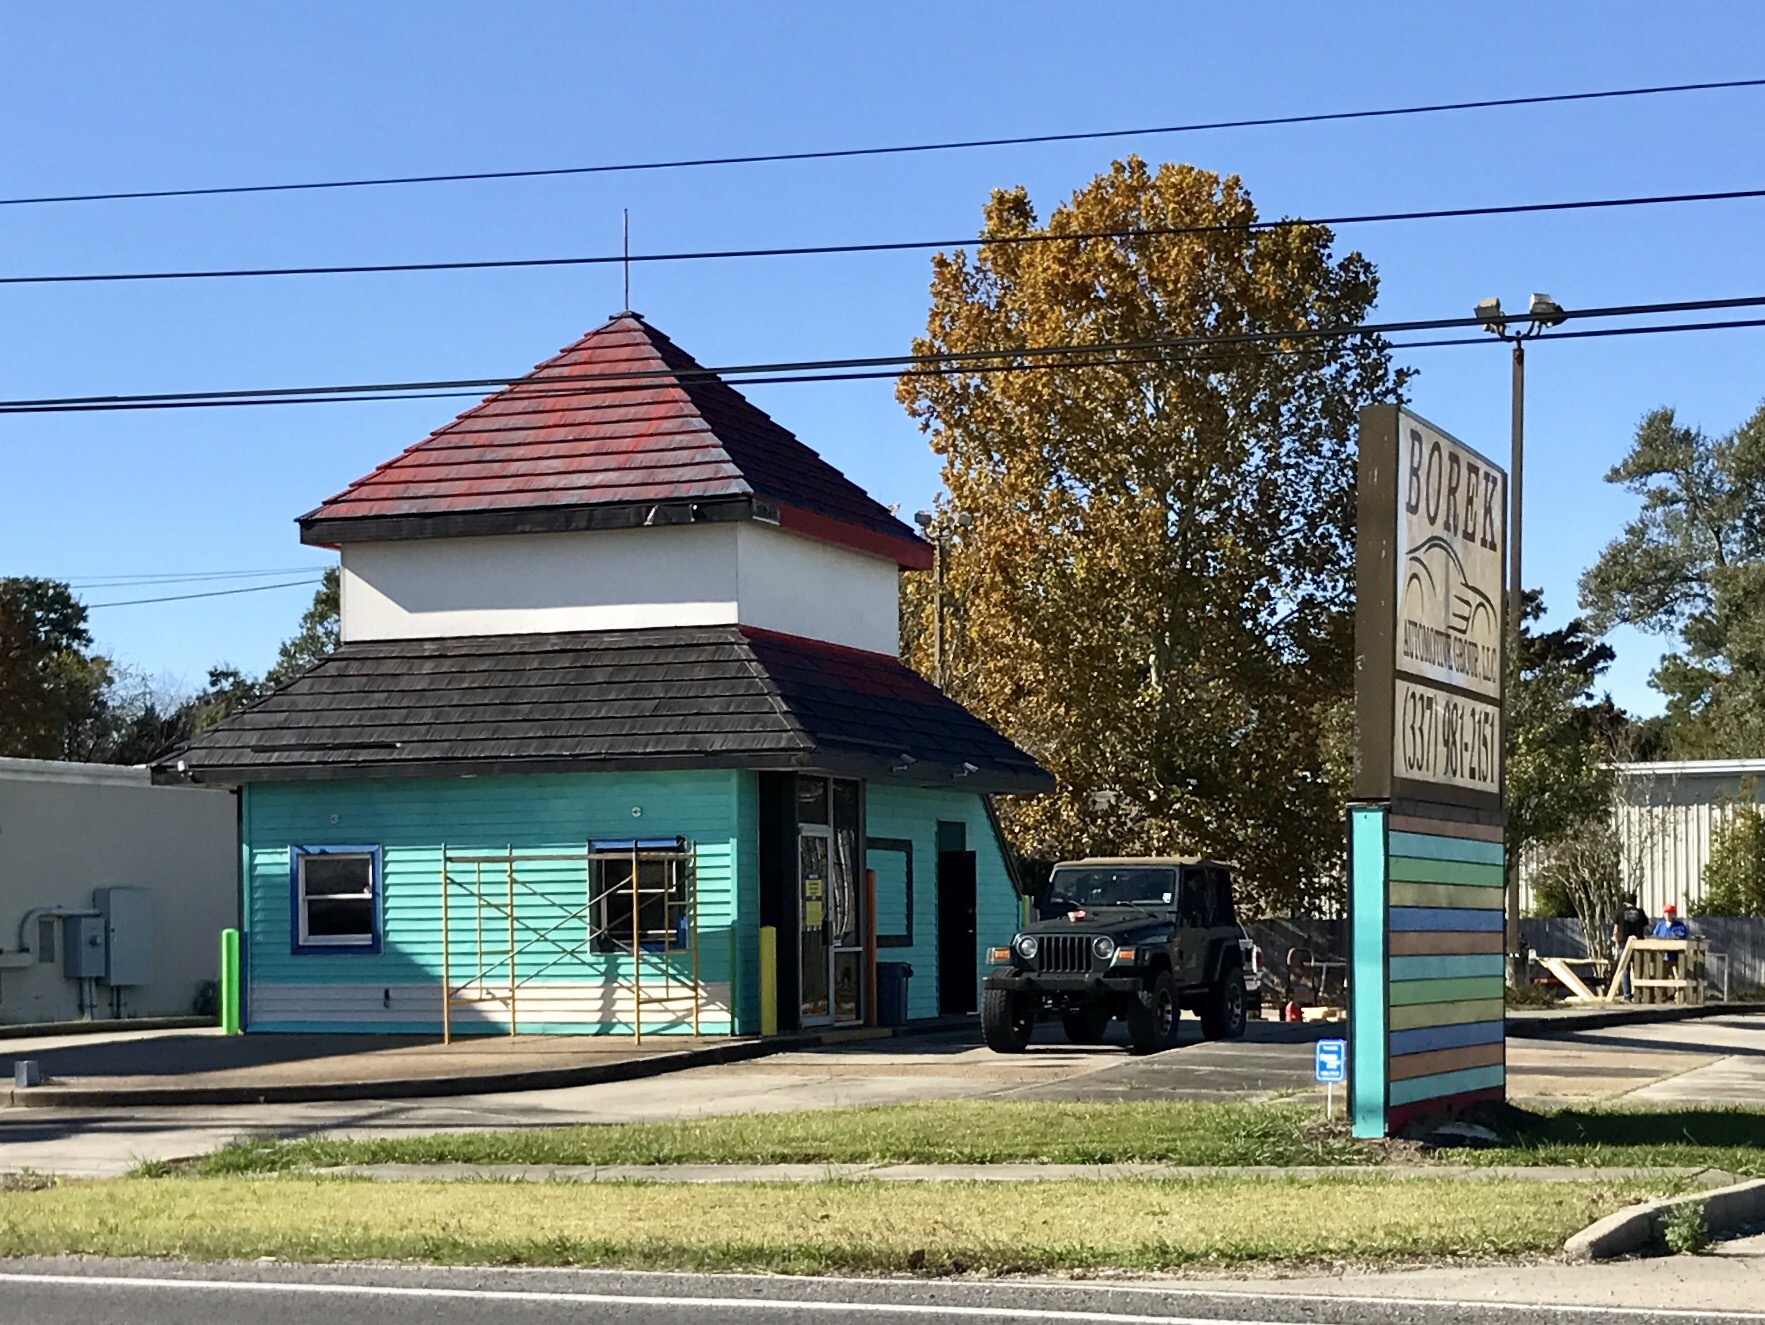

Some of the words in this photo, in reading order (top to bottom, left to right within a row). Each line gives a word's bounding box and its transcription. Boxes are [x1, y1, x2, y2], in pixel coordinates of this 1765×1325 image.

[1406, 428, 1498, 552] BOREK
[1403, 619, 1453, 671] AUTOMOTIVE
[1482, 645, 1497, 684] LLC
[1402, 686, 1438, 778] (337)
[1442, 699, 1496, 783] 981-2151
